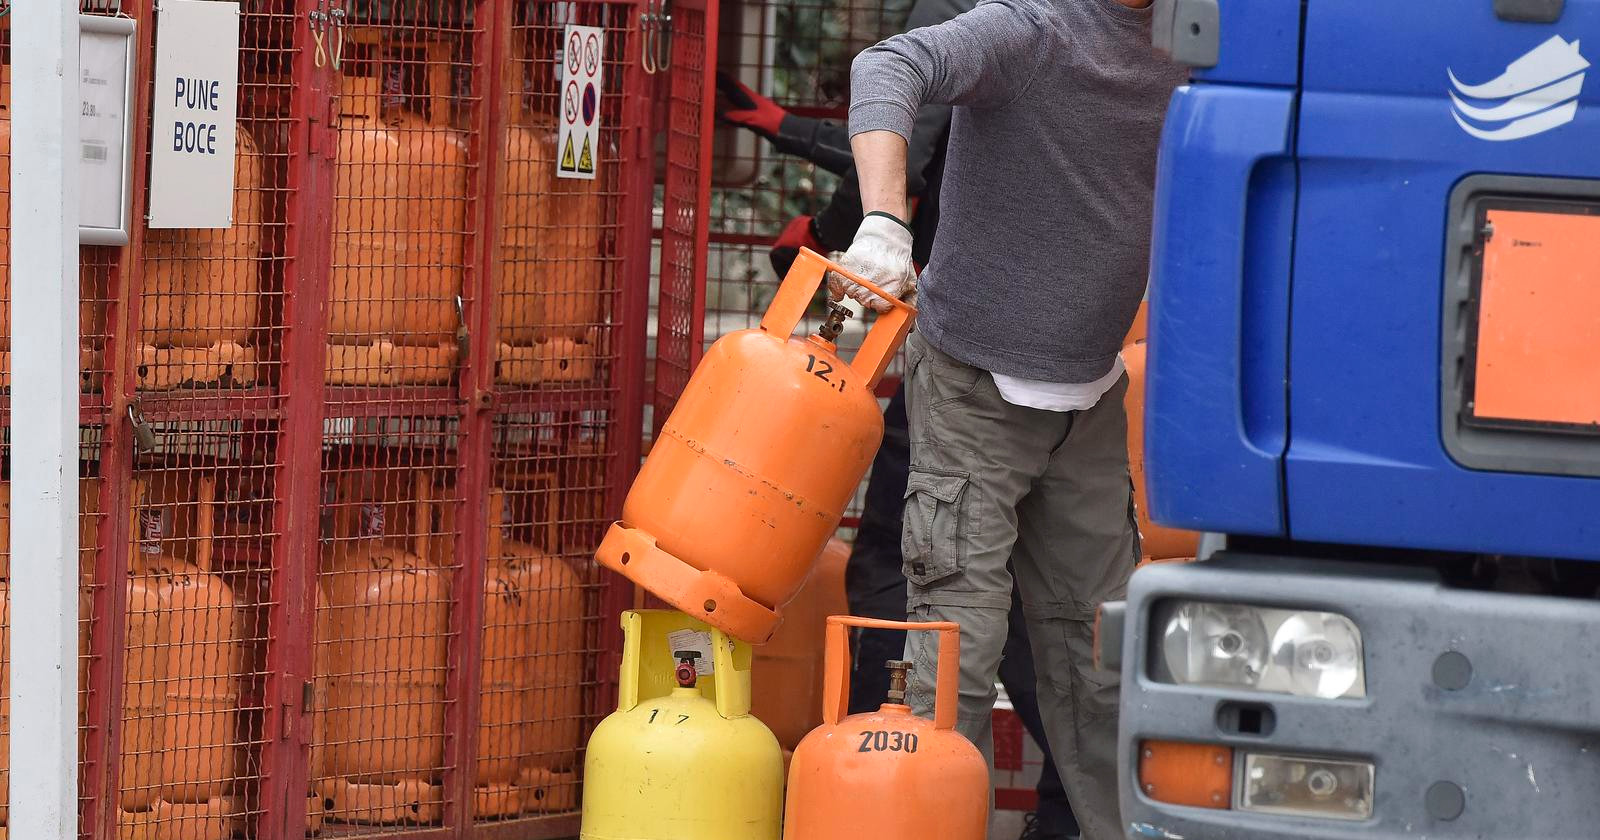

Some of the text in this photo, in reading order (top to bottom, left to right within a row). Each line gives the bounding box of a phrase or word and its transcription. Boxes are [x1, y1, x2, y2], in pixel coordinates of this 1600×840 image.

[175, 77, 219, 111] PUNE
[173, 121, 217, 154] BOCE
[806, 354, 846, 392] 12.1
[858, 730, 918, 753] 2030
